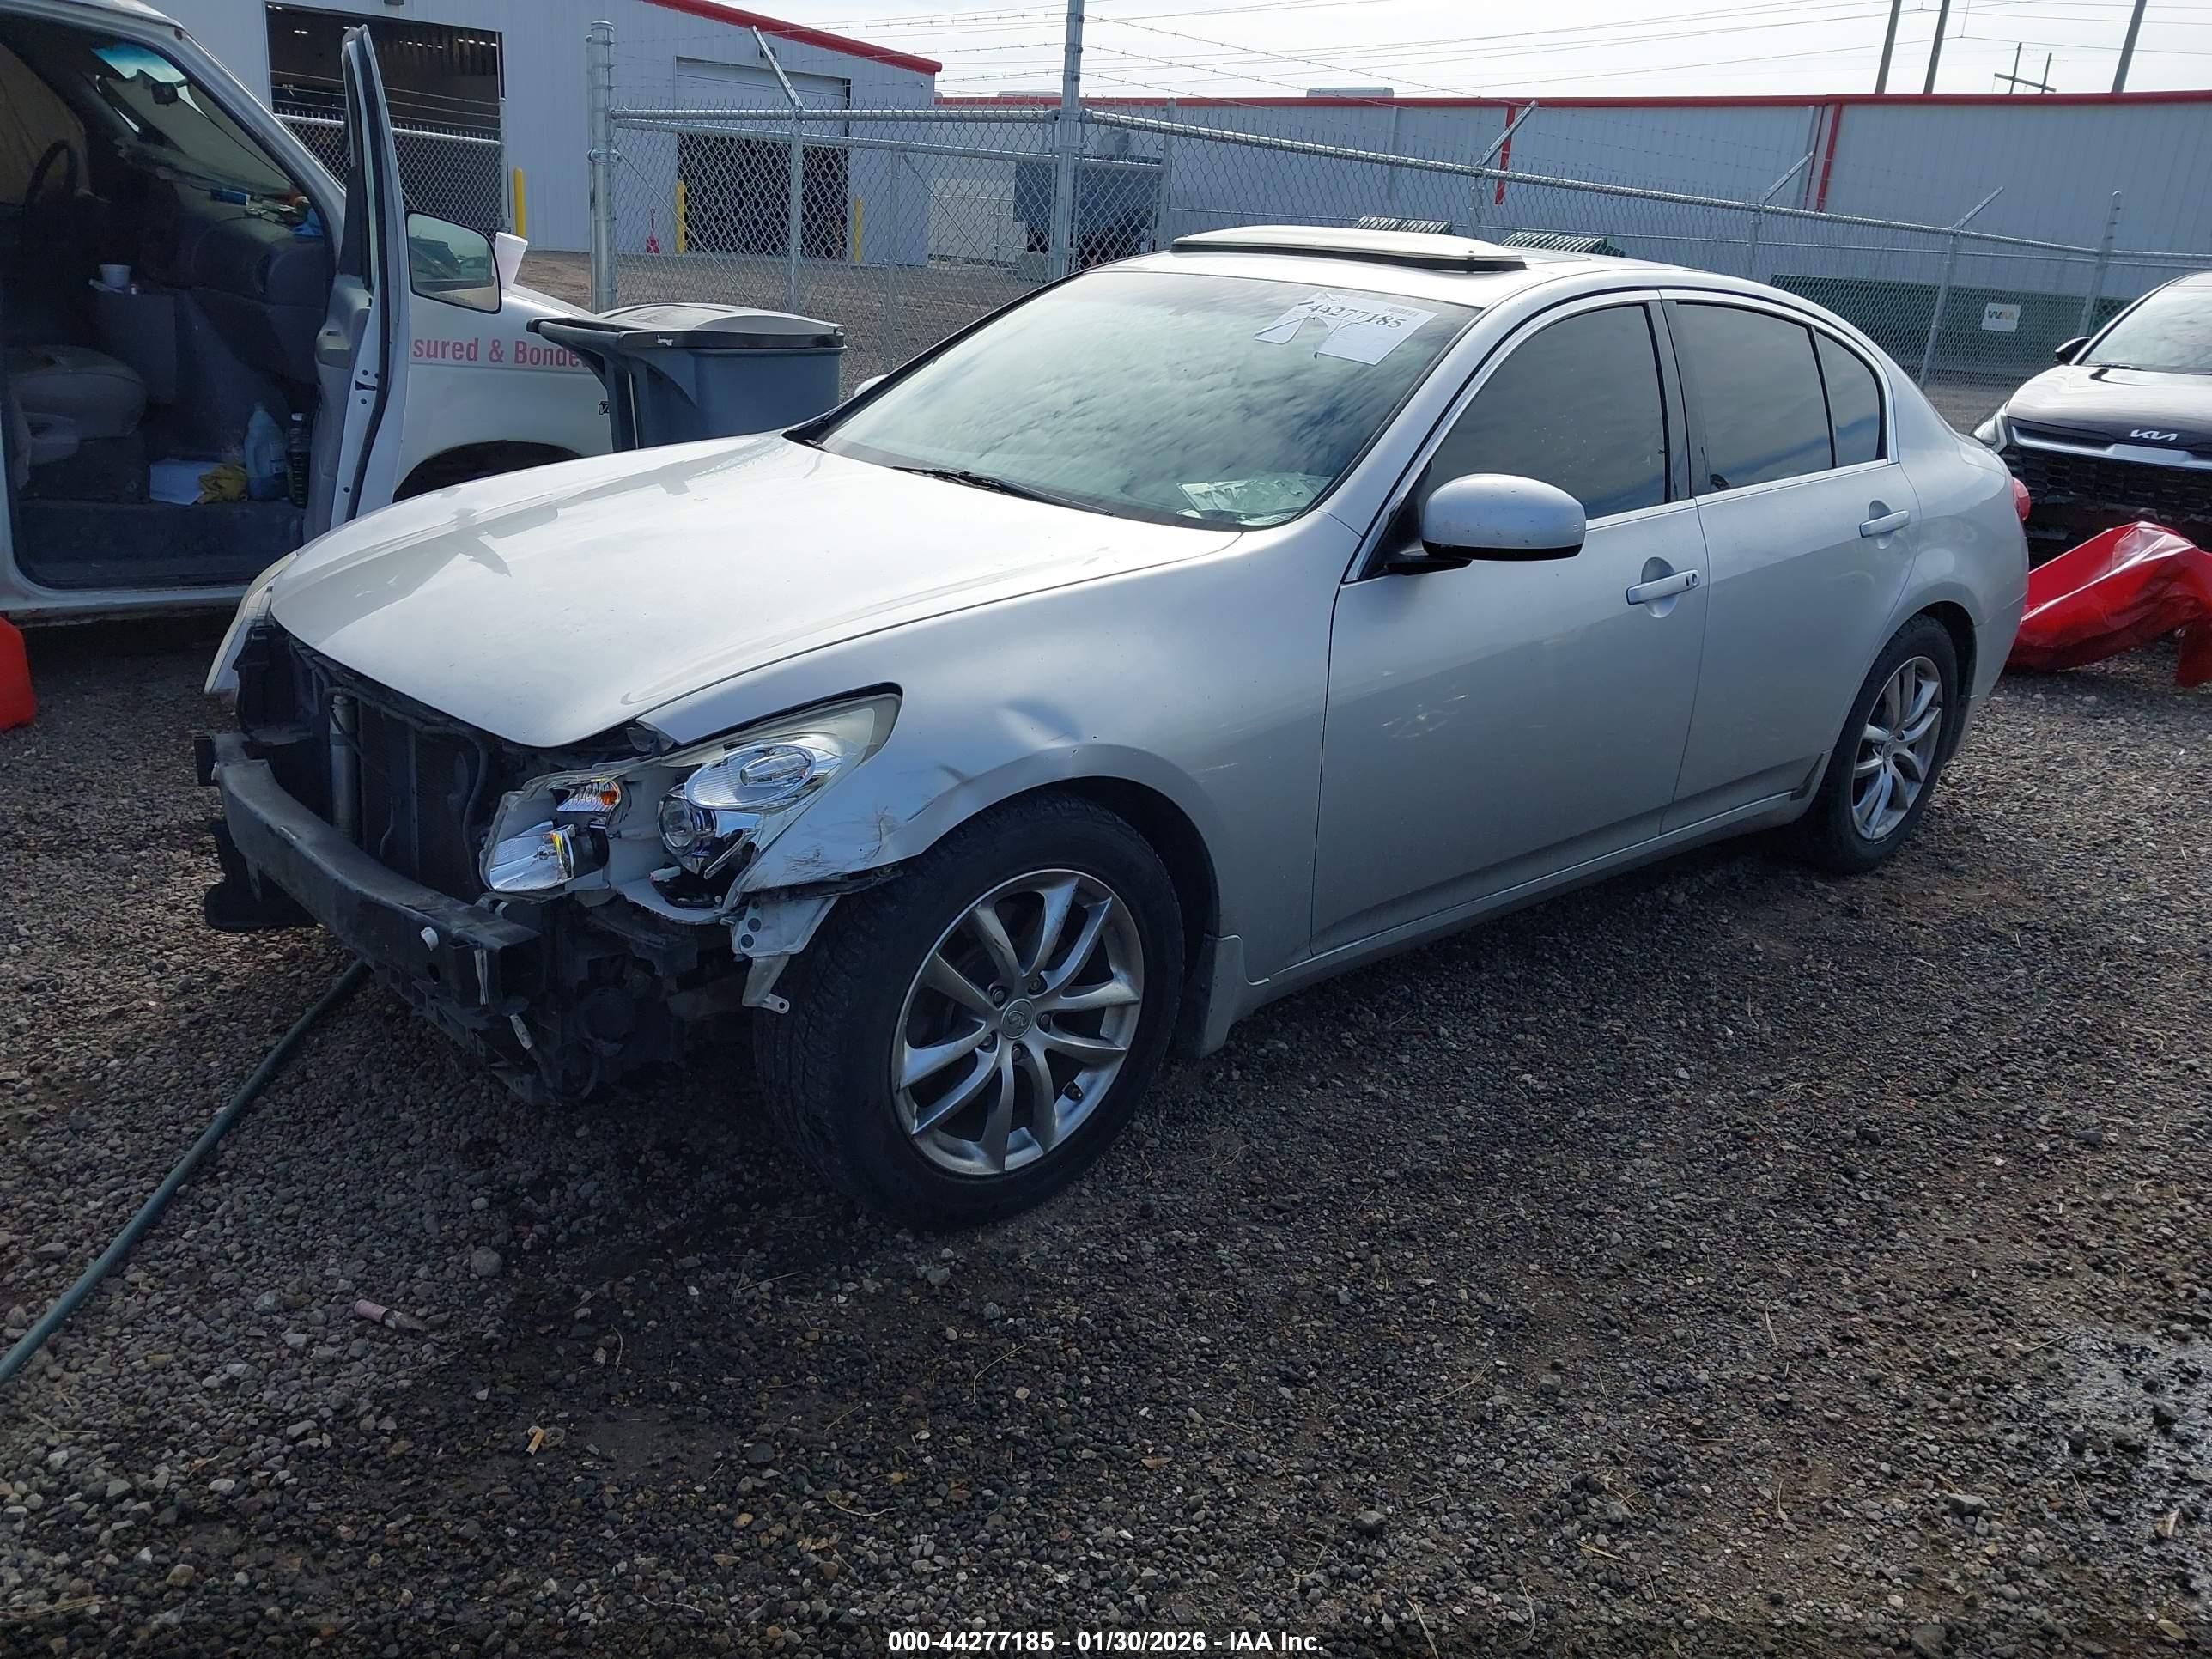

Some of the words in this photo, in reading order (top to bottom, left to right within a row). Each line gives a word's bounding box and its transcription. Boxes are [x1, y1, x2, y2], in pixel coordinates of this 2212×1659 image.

[488, 338, 504, 363] &
[514, 340, 588, 368] Bonde
[2130, 429, 2178, 441] KIA
